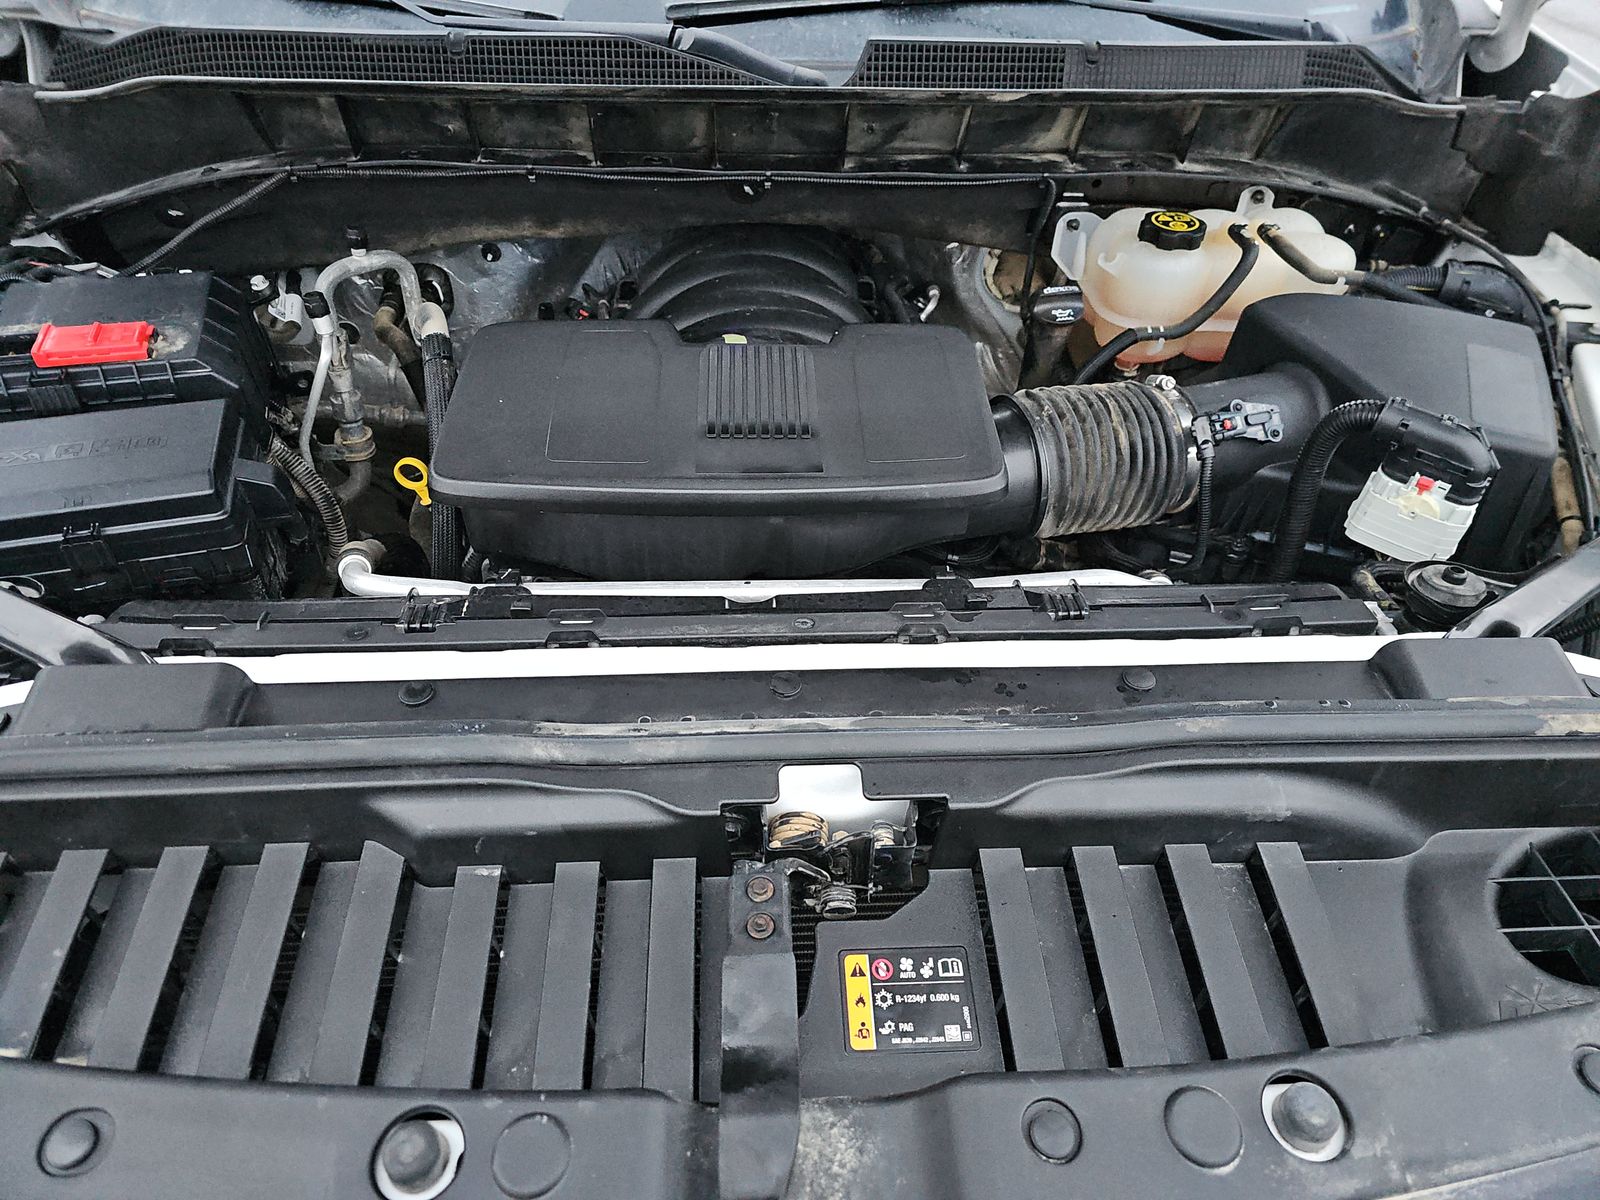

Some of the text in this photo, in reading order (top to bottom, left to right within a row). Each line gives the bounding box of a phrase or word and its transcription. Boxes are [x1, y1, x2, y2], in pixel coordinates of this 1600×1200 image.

[900, 971, 916, 979] AUTO
[895, 993, 960, 1003] R-1234yf 0.600 kg
[898, 1022, 914, 1032] PAG
